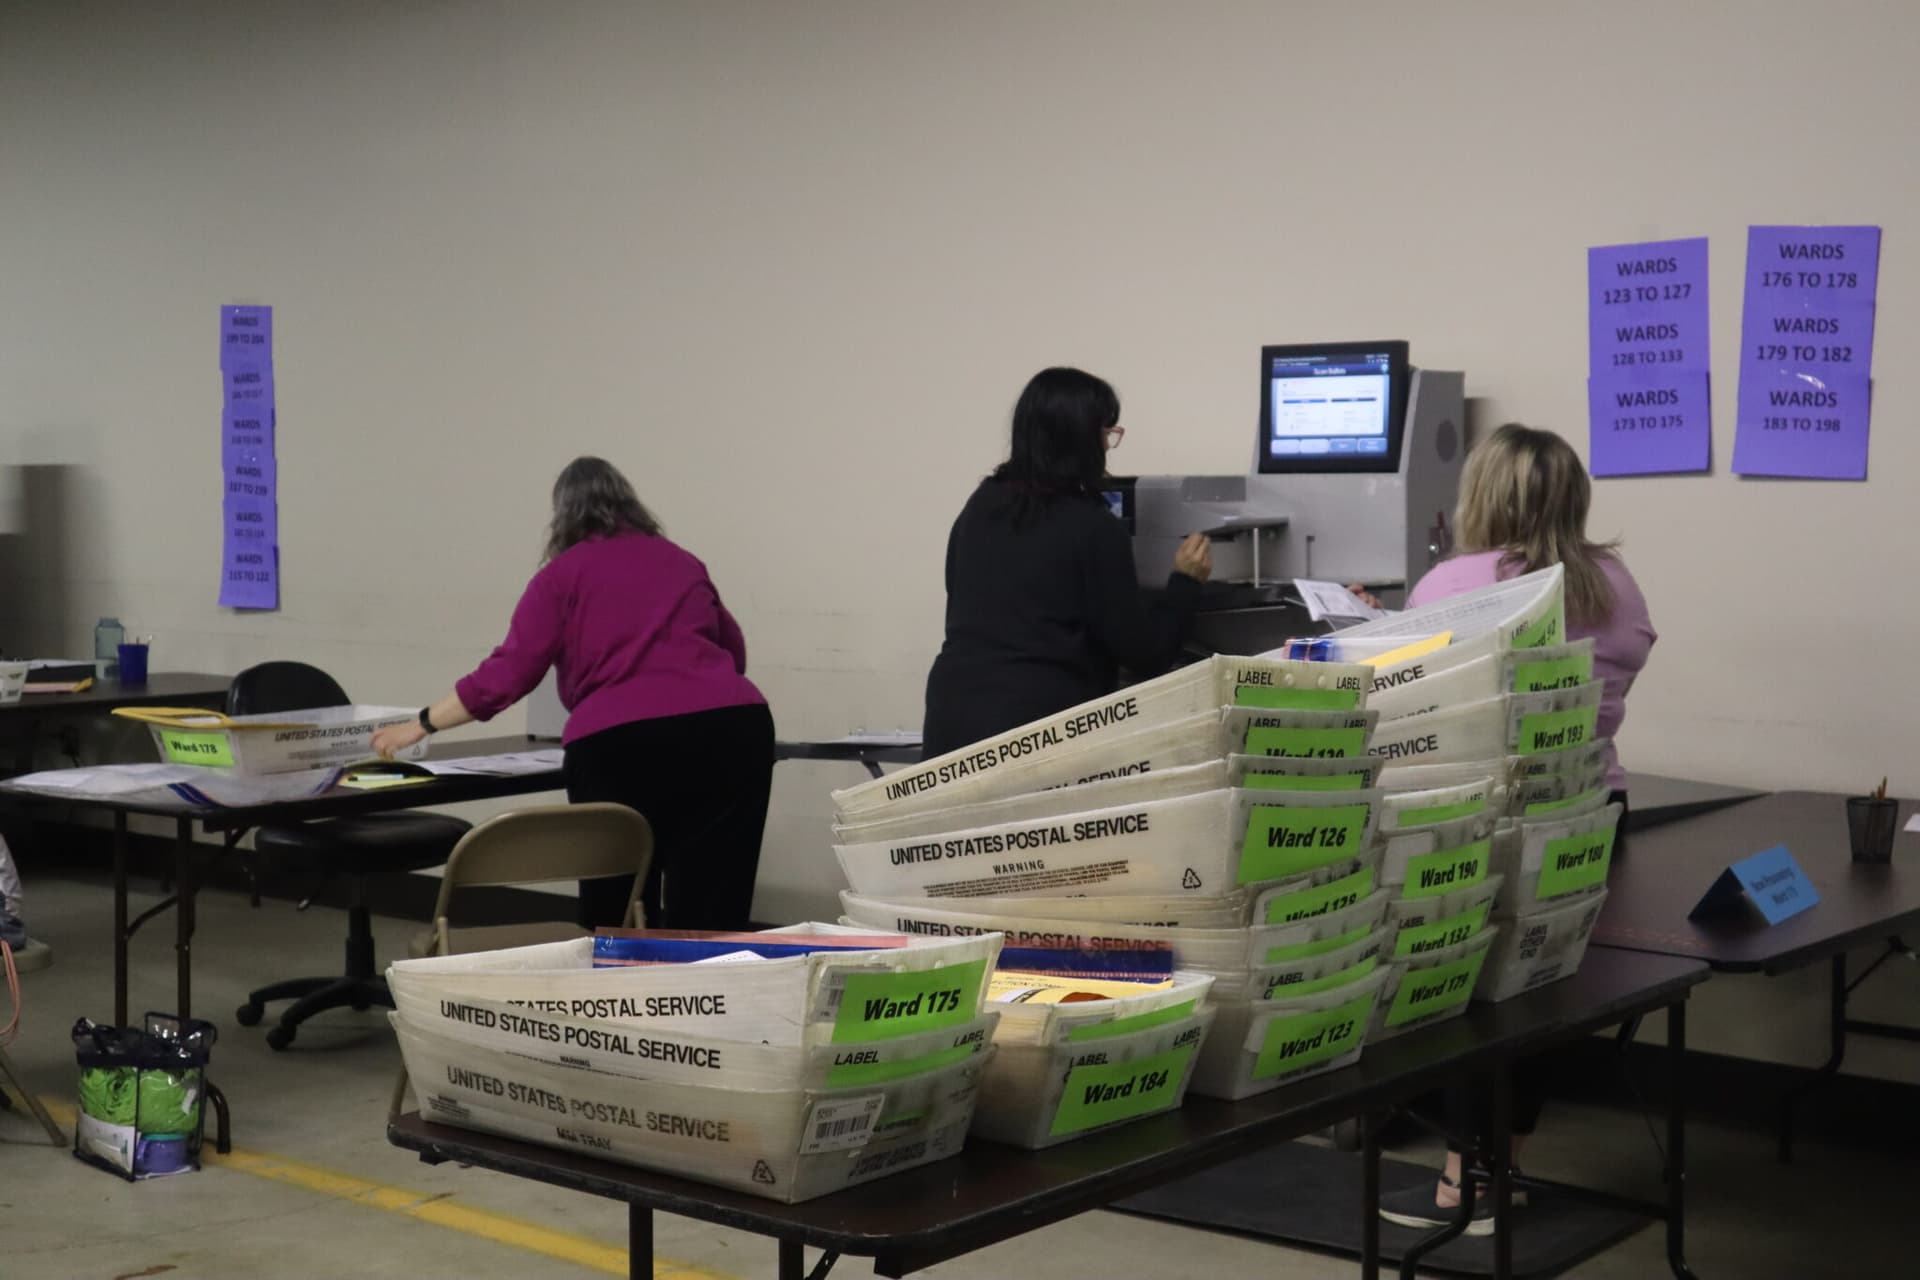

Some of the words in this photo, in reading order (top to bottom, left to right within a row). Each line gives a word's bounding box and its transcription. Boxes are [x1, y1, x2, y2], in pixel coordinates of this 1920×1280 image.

[1778, 244, 1844, 260] WARDS
[1617, 258, 1677, 276] WARDS
[1763, 272, 1792, 288] 176
[1799, 273, 1821, 288] TO
[1828, 273, 1857, 289] 178
[1604, 289, 1631, 305] 123
[1637, 286, 1658, 301] TO
[1663, 284, 1691, 299] 127
[1616, 324, 1678, 343] WARDS
[1774, 318, 1839, 334] WARDS
[1613, 353, 1635, 367] 128
[1639, 351, 1656, 364] TO
[1660, 350, 1683, 363] 133
[1757, 346, 1787, 361] 179
[1792, 346, 1815, 361] TO
[1822, 347, 1851, 362] 182
[1616, 390, 1678, 408] WARDS
[1770, 391, 1837, 407] WARDS
[1613, 418, 1636, 431] 173
[1640, 417, 1656, 429] TO
[1661, 415, 1683, 427] 175
[1763, 418, 1787, 431] 183
[1792, 418, 1811, 431] TO
[1816, 419, 1840, 432] 198
[1237, 670, 1274, 686] LABEL
[1336, 676, 1361, 691] LABEL
[1368, 665, 1426, 694] RVICE
[275, 730, 309, 742] UNITED
[310, 728, 343, 740] STATES
[1533, 728, 1565, 750] Ward
[1567, 725, 1584, 744] 193
[172, 741, 198, 753] Ward
[199, 743, 217, 754] 178
[886, 772, 937, 801] UNITED
[940, 750, 998, 783] STATES
[999, 727, 1063, 763] POSTAL
[1065, 697, 1139, 739] SERVICE
[1266, 748, 1314, 758] Wd
[1367, 734, 1439, 761] SERVICE
[890, 843, 942, 866] UNITED
[945, 834, 1004, 859] STATES
[1006, 827, 1070, 851] POSTAL
[1074, 813, 1149, 841] SERVICE
[1267, 827, 1315, 848] Ward
[1318, 827, 1347, 847] 126
[993, 860, 1045, 875] WARNING
[1556, 847, 1587, 871] Ward
[1420, 866, 1455, 889] Ward
[1458, 860, 1479, 880] 190
[1269, 973, 1305, 987] LABEL
[1408, 980, 1446, 1005] Ward
[507, 1000, 568, 1015] TES
[572, 998, 642, 1019] POSTAL
[645, 995, 727, 1018] SERVICE
[865, 992, 925, 1022] Ward
[927, 988, 962, 1013] 175
[440, 1001, 496, 1028] UNITED
[500, 1013, 561, 1043] STATES
[564, 1026, 635, 1057] POSTAL
[638, 1041, 721, 1070] SERVICE
[954, 1029, 985, 1048] LABEL
[1173, 1026, 1202, 1046] LABEL
[1279, 1028, 1322, 1060] Ward
[1324, 1019, 1355, 1042] 123
[834, 1050, 880, 1067] LABEL
[1068, 1053, 1109, 1070] LABEL
[1083, 1075, 1137, 1105] Ward
[1138, 1070, 1169, 1094] 184
[446, 1066, 505, 1097] UNITED
[508, 1082, 568, 1115] STATES
[570, 1099, 641, 1129] POSTAL
[645, 1112, 731, 1142] SERVICE
